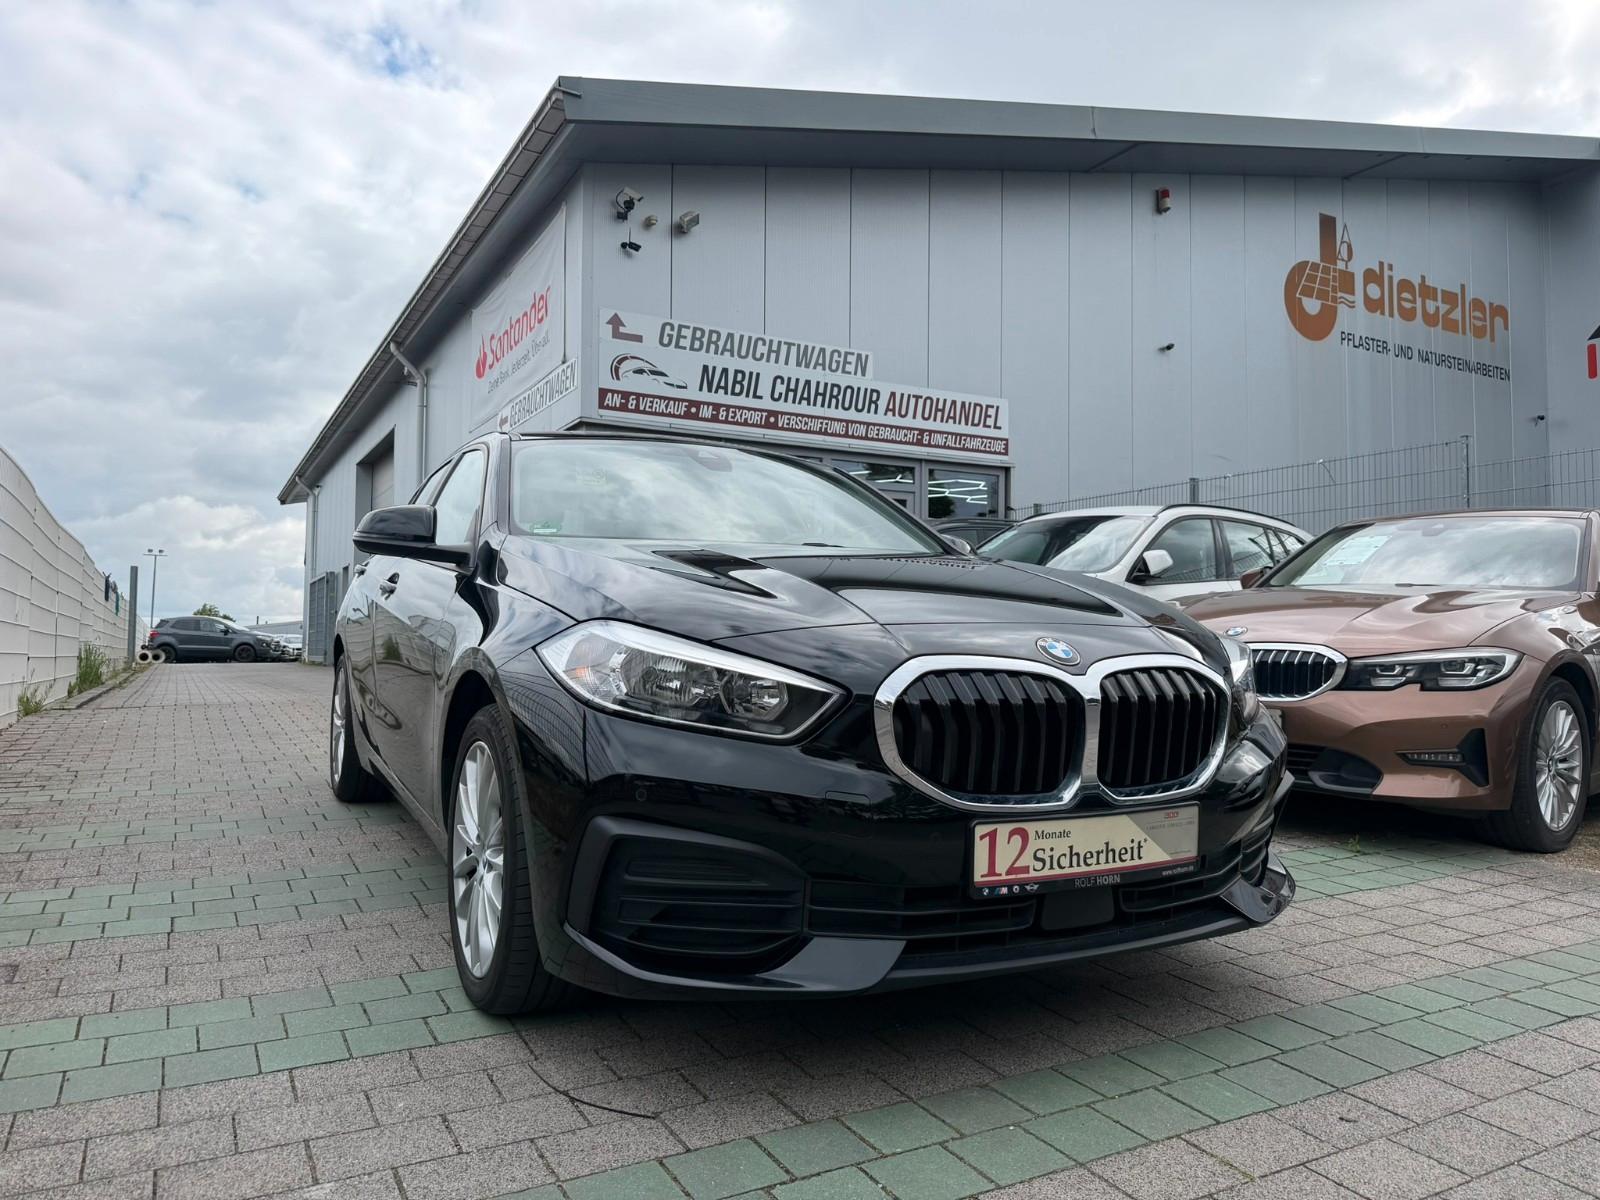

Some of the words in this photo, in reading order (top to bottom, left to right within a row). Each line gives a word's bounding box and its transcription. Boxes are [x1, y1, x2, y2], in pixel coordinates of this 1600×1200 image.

[488, 285, 551, 370] Santander
[1363, 260, 1509, 343] dietzler
[658, 321, 869, 377] GEBRAUCHTWAGEN
[1341, 331, 1391, 356] PFLASTER-
[1394, 343, 1413, 360] UND
[1417, 348, 1511, 382] NATURSTEINARBEITEN
[509, 360, 577, 428] GEBRAUCHTWAGEN
[604, 392, 626, 408] AN-
[628, 395, 637, 409] &
[639, 397, 688, 416] VERKAUF
[699, 404, 717, 419] IM-
[719, 408, 728, 421] &
[728, 409, 768, 425] EXPORT
[777, 415, 846, 435] VERSCHIFFUNG
[849, 423, 866, 438] VON
[867, 425, 921, 444] GEBRAUCHT-
[923, 432, 930, 444] &
[931, 433, 1006, 453] UNFALLFAHRZEUGE
[698, 364, 763, 400] NABIL
[770, 375, 881, 415] CHAHROUR
[884, 391, 1002, 430] AUTOHANDEL
[979, 827, 1031, 878] 12
[1034, 829, 1072, 841] Monate
[1074, 876, 1096, 888] ROLF
[1096, 874, 1121, 885] HORN
